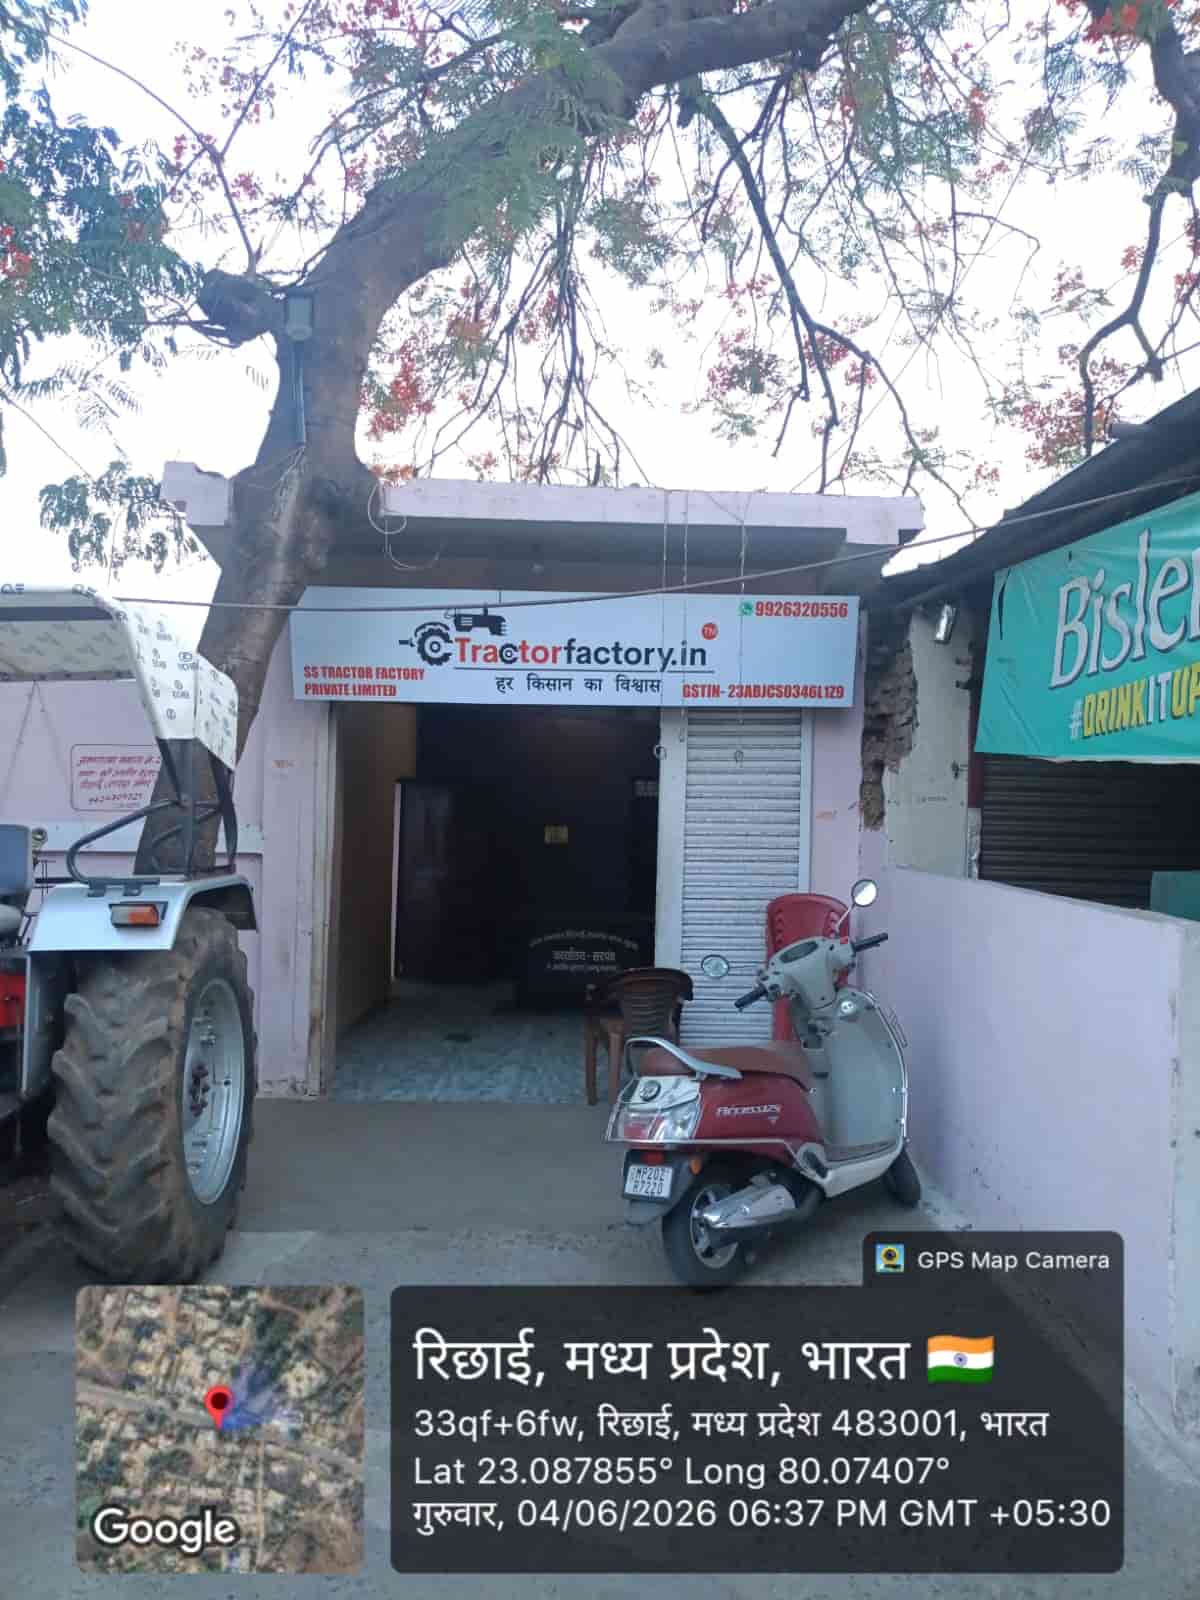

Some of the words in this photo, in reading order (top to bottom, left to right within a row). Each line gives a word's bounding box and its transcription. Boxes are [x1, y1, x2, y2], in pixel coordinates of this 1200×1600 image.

[755, 601, 848, 618] 9926320556
[455, 637, 707, 673] Tractorfactory.in
[304, 665, 319, 679] SS
[321, 666, 373, 680] TRACTOR
[376, 667, 425, 681] FACTORY
[305, 683, 350, 696] PRIVATE
[352, 684, 397, 697] LIMITED
[495, 676, 515, 694] हर
[526, 673, 574, 692] किसान
[584, 678, 603, 692] का
[615, 674, 662, 694] विश्वास
[683, 684, 726, 699] GSTIN-
